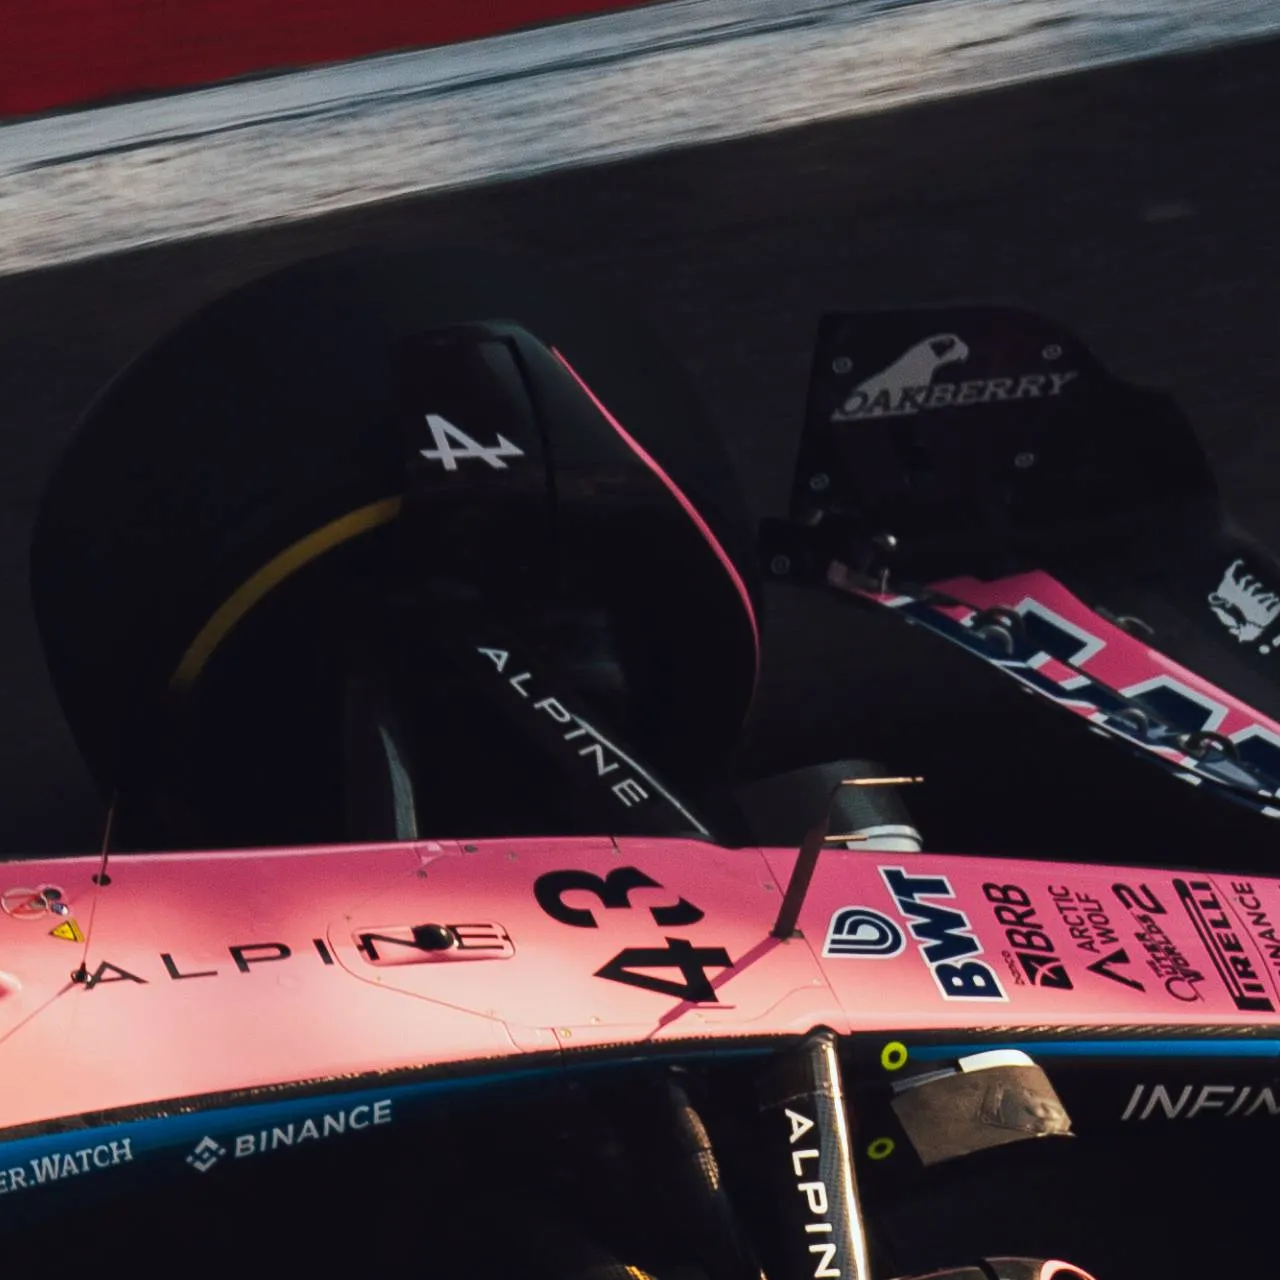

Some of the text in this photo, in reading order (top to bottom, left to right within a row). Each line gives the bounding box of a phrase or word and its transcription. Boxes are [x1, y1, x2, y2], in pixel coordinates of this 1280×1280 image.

[840, 370, 1080, 415] OAKBERRY
[476, 646, 648, 806] ALPINE
[533, 866, 734, 1003] 43
[877, 864, 1011, 1003] BWT
[982, 881, 1056, 954] BRB
[1047, 884, 1100, 954] ARCTIC
[1075, 891, 1120, 946] WOLF
[1171, 877, 1276, 1012] PIRELLI
[84, 922, 509, 991] ALPINE
[234, 1099, 394, 1160] BINANCE
